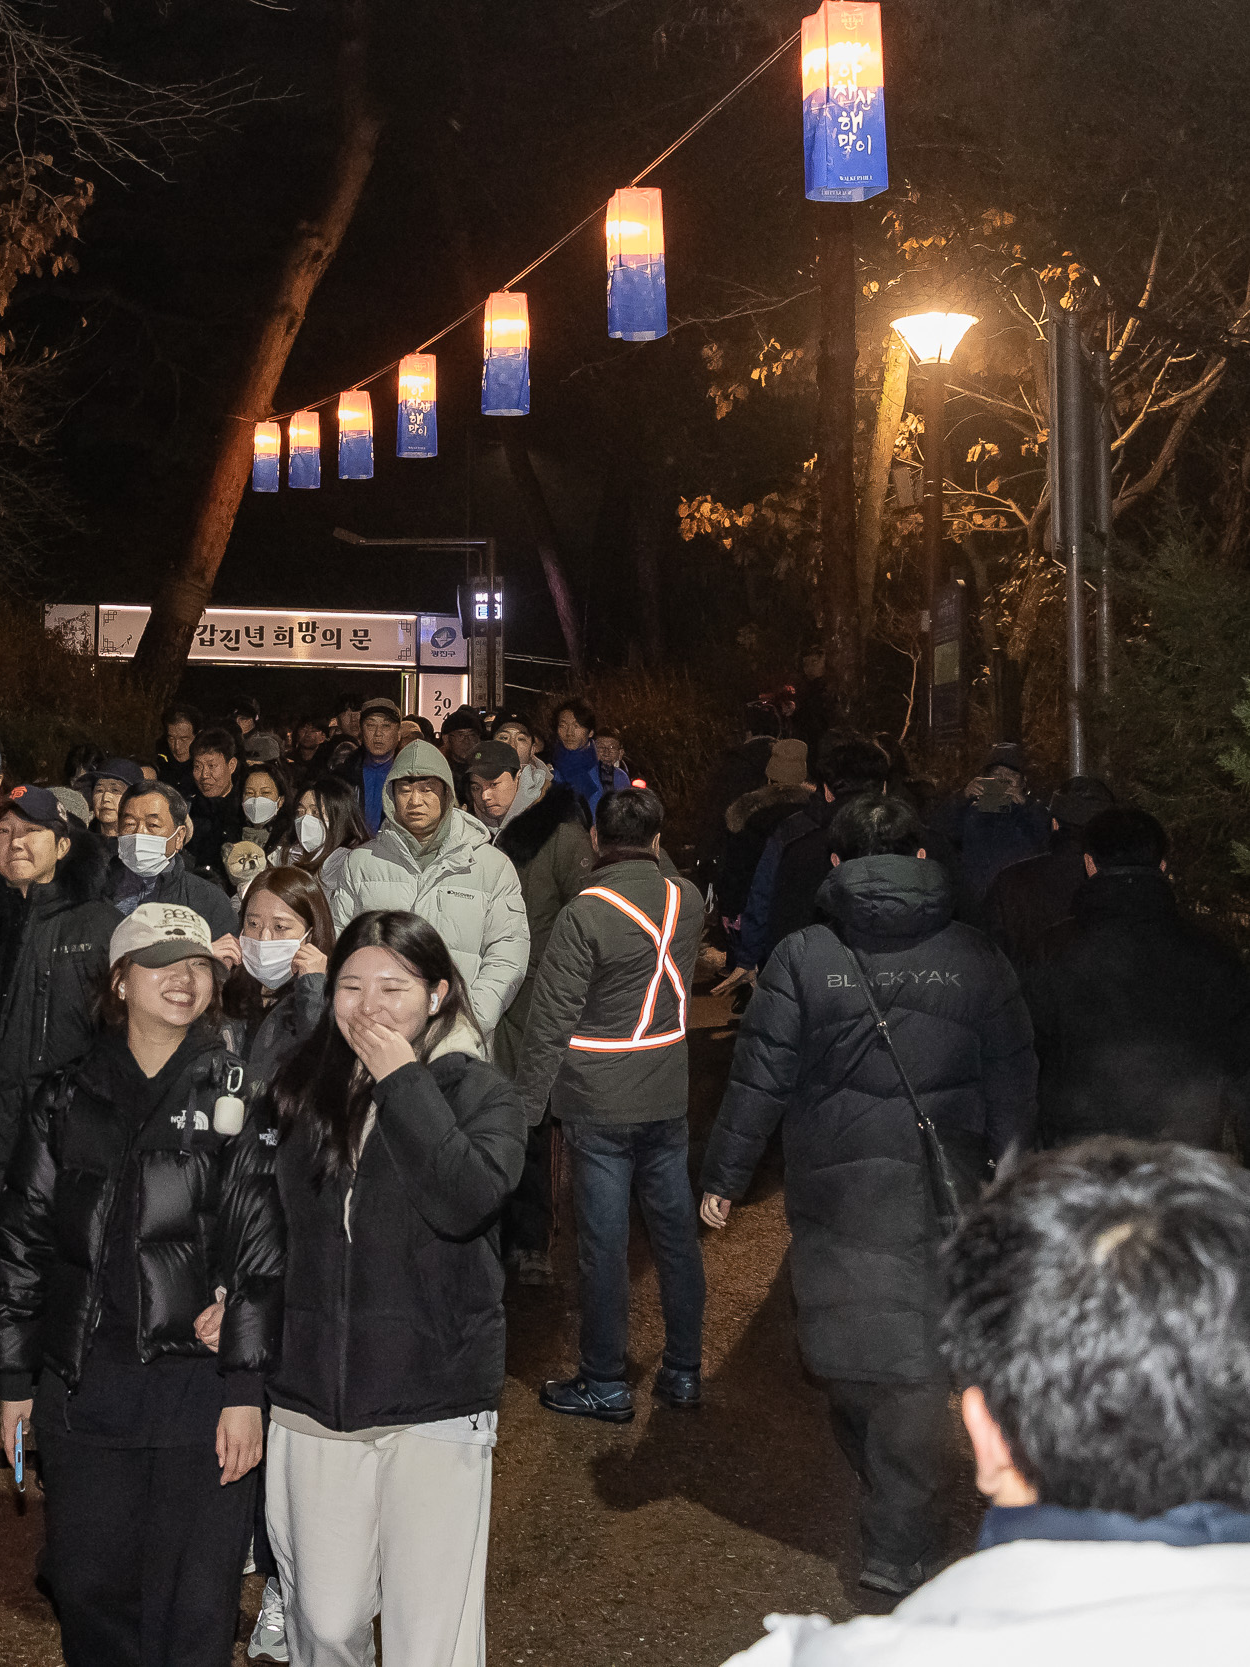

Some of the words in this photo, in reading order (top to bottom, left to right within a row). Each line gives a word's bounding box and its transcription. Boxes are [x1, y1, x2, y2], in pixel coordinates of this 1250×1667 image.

[196, 624, 265, 651] 갑진년
[273, 621, 342, 650] 희망의
[350, 629, 372, 651] 문
[431, 650, 456, 658] 광진구
